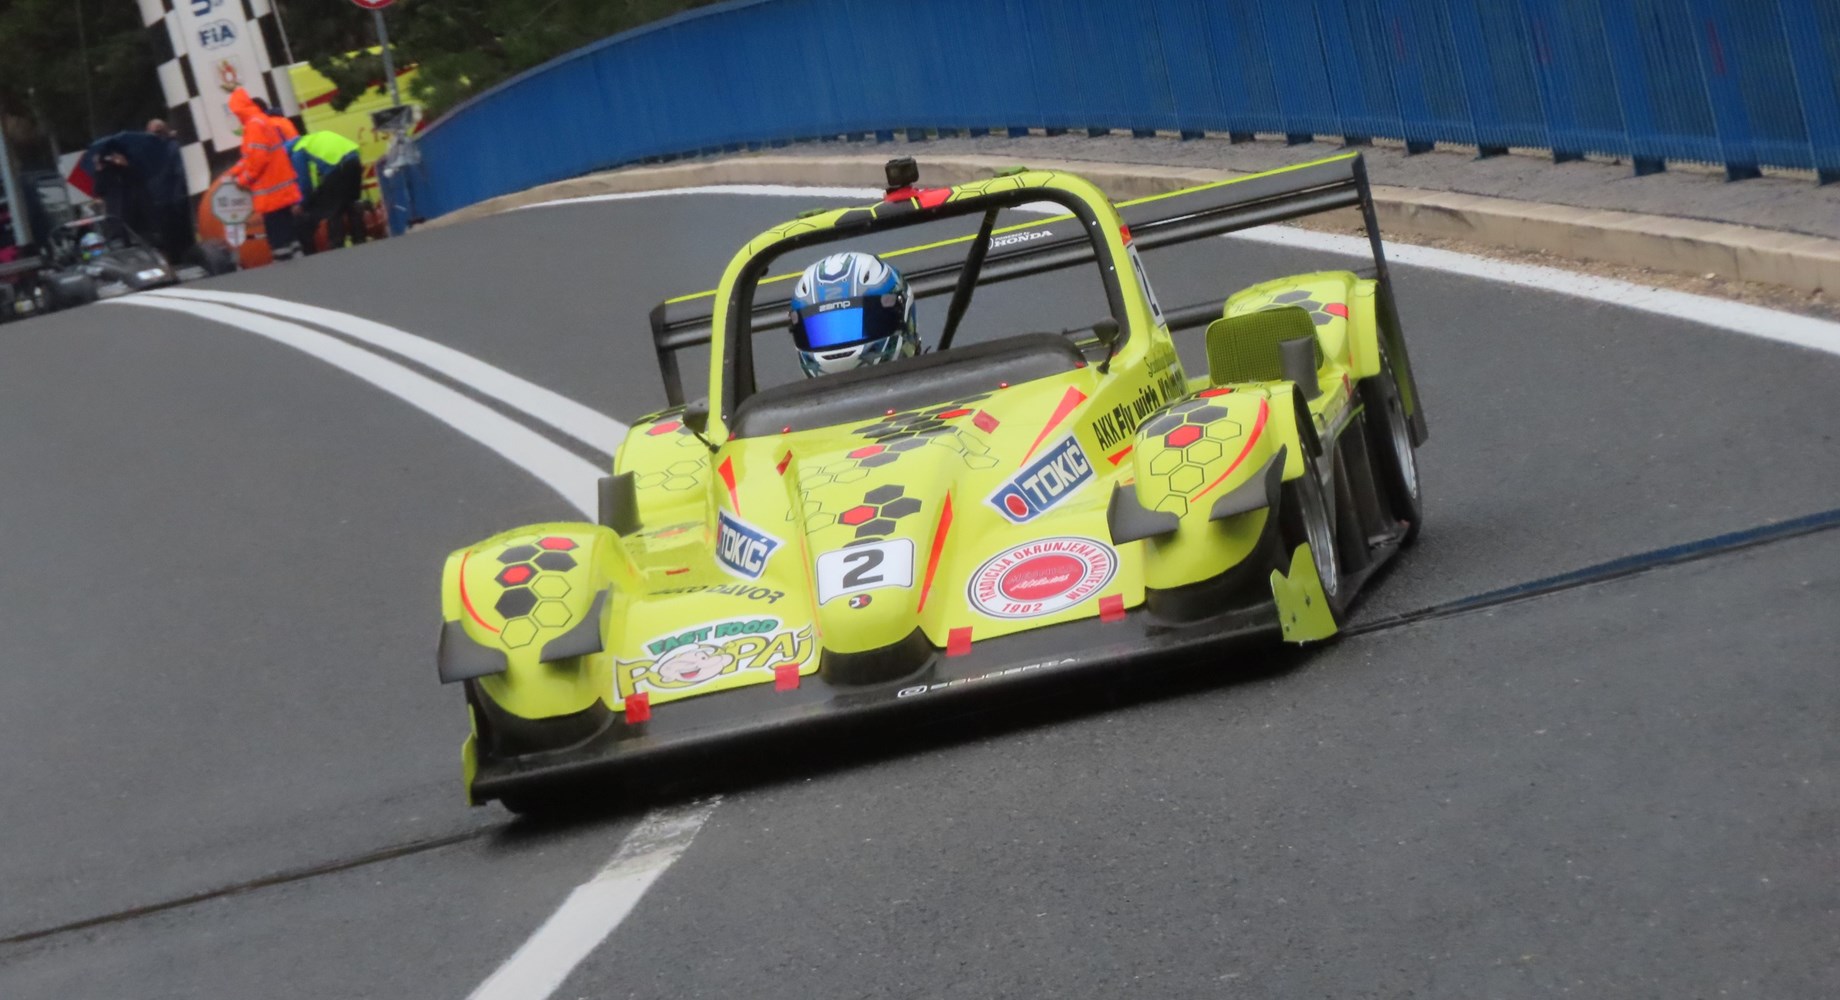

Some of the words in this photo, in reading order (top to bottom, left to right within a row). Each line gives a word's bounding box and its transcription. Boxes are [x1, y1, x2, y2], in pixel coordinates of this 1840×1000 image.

[994, 230, 1053, 248] HONDA
[1133, 254, 1160, 317] 2
[1092, 412, 1121, 451] AKK
[1132, 384, 1161, 420] with
[1021, 440, 1088, 504] TOKIĆ
[721, 524, 768, 573] TOKIĆ
[842, 549, 884, 589] 2
[979, 557, 1014, 603] TRADICIJA
[1012, 541, 1096, 561] OKRUNJENA
[1065, 547, 1108, 601] KVALITETOM
[1002, 602, 1043, 613] 1902
[648, 626, 712, 655] FAST
[714, 619, 778, 638] FOOD
